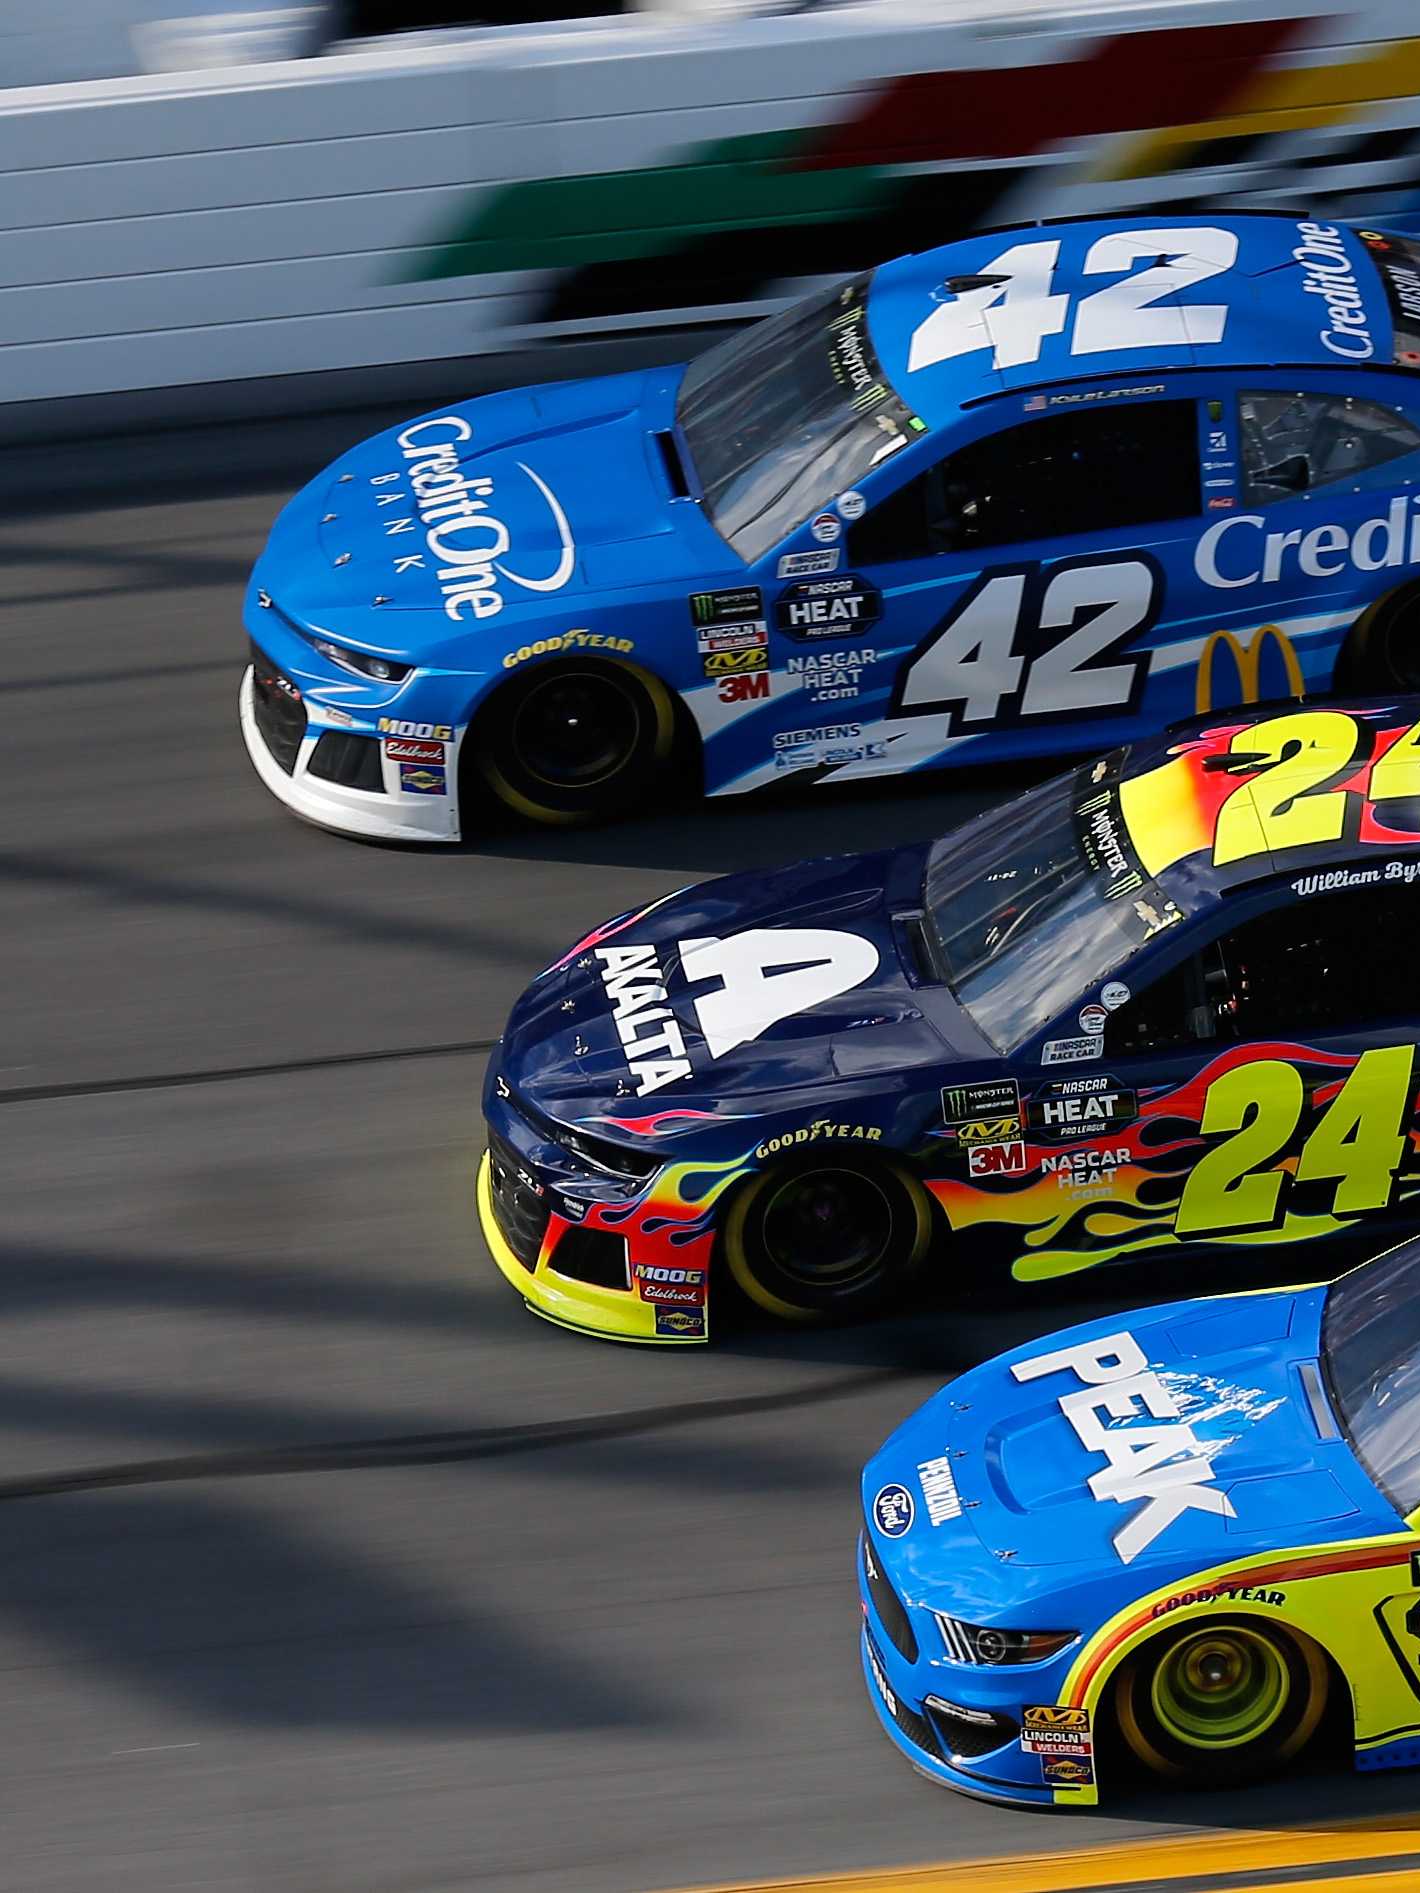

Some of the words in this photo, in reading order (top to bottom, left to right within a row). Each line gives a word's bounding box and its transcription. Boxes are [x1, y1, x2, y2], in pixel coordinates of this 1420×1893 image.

[907, 227, 1238, 372] 42
[1292, 222, 1374, 358] CreditOne
[370, 474, 425, 574] BANK
[397, 416, 510, 622] CreditOne
[789, 596, 864, 625] HEAT
[901, 561, 1153, 721] 42
[787, 650, 877, 674] NASCAR
[718, 673, 771, 704] 3M
[803, 669, 862, 689] HEAT
[810, 687, 858, 702] .com
[378, 717, 453, 740] MOOG
[774, 723, 861, 748] SIEMENS
[1090, 808, 1130, 879] MONSTER
[1290, 869, 1382, 896] William
[594, 945, 693, 1097] AXALTA
[1050, 1051, 1074, 1061] RACE
[1076, 1048, 1095, 1058] CAR
[1062, 1078, 1108, 1095] NASCAR
[1043, 1095, 1119, 1125] HEAT
[755, 1119, 882, 1159] GOODYEAR
[1060, 1126, 1077, 1136] PRO
[1077, 1123, 1107, 1134] LEAGUE
[1175, 1044, 1416, 1234] 24
[971, 1143, 1024, 1175] 3M
[1041, 1148, 1131, 1173] NASCAR
[1058, 1168, 1118, 1189] HEAT
[635, 1264, 702, 1284] MOOG
[644, 1286, 698, 1302] Edelbrock
[658, 1315, 702, 1327] SUNOCO
[1010, 1330, 1239, 1564] PEAK
[917, 1456, 962, 1527] PENNZOIL
[876, 1489, 911, 1532] Ford
[1152, 1583, 1286, 1618] GOODYEAR
[1024, 1731, 1079, 1743] LINCOLN
[1036, 1743, 1086, 1753] WELDERS
